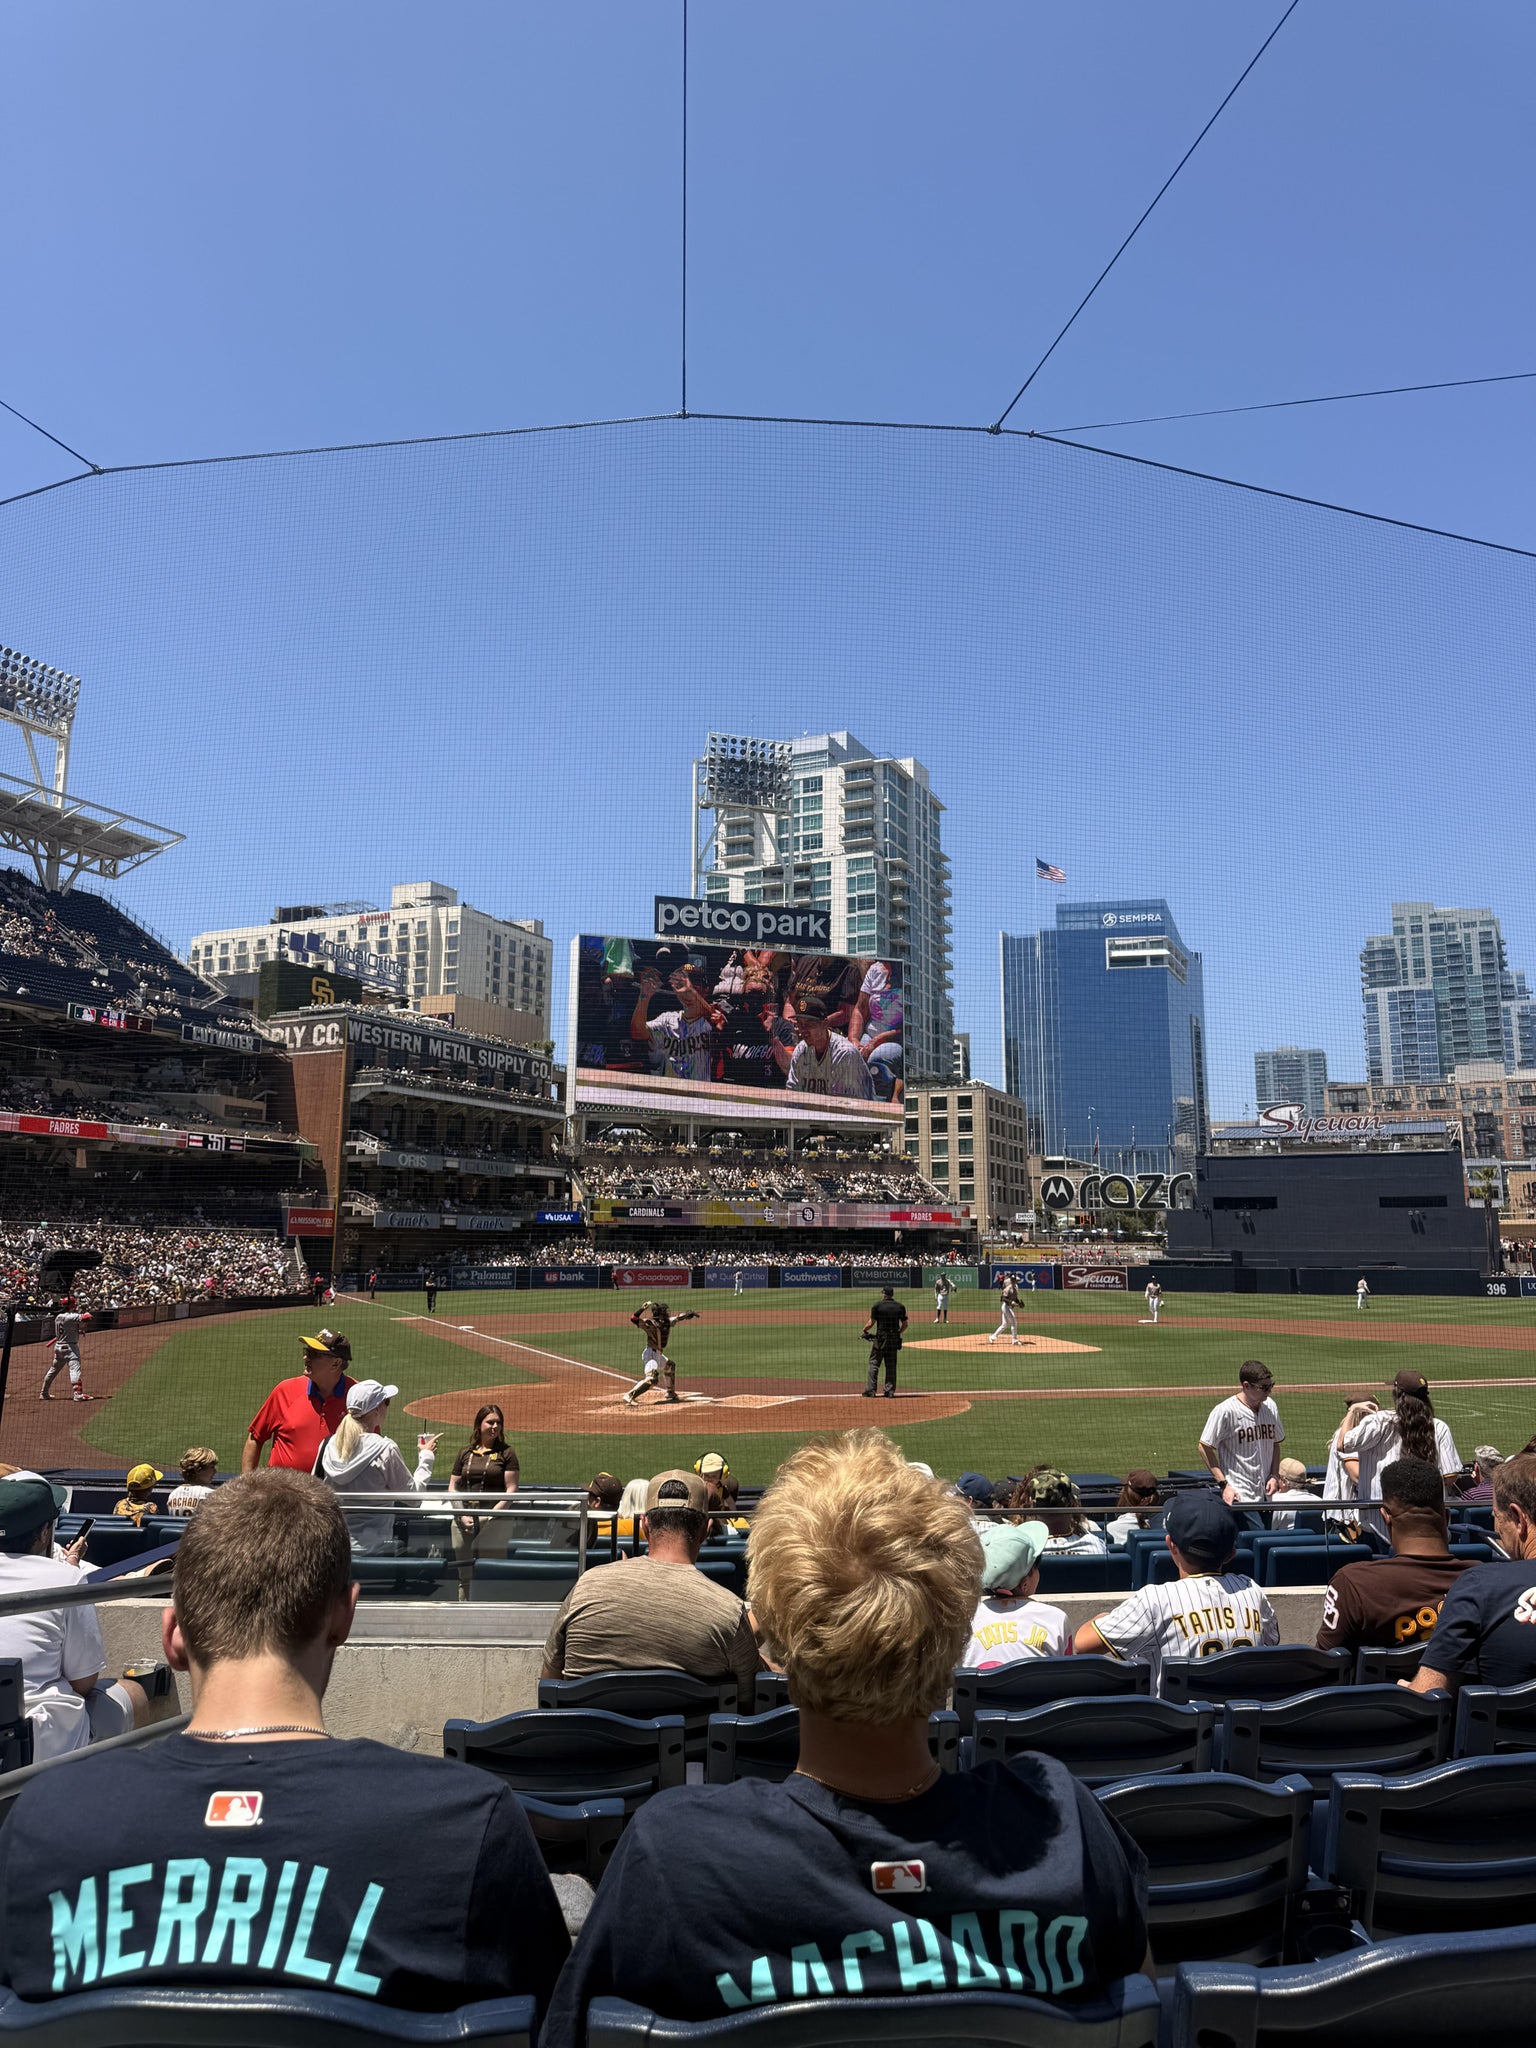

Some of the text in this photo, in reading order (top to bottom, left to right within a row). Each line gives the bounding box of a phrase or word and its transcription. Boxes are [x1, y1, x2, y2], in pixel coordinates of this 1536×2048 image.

[658, 901, 827, 940] petco park
[1119, 913, 1162, 923] SEMPRA
[192, 1026, 255, 1051] CUTWATER
[312, 1022, 344, 1047] CO.
[349, 1020, 551, 1080] WESTERN METAL SUPPLY CO.
[49, 1120, 80, 1135] PADRES
[1261, 1101, 1387, 1142] Sycuan
[397, 1153, 428, 1168] ORIS
[1079, 1172, 1193, 1210] razr
[629, 1207, 665, 1217] CARDINALS
[910, 1212, 932, 1221] PADRES
[343, 1228, 360, 1241] 336
[470, 1270, 513, 1280] Palomar
[559, 1271, 585, 1281] bank
[637, 1272, 683, 1282] Snapdragon
[719, 1272, 765, 1282] QuilOrtho
[784, 1271, 832, 1282] Southwest
[1067, 1267, 1121, 1288] Sycuan
[1486, 1283, 1507, 1295] 396
[1172, 1606, 1262, 1641] TATIS JR
[973, 1621, 1048, 1651] TATIS JR
[49, 1856, 384, 1996] MERRILL
